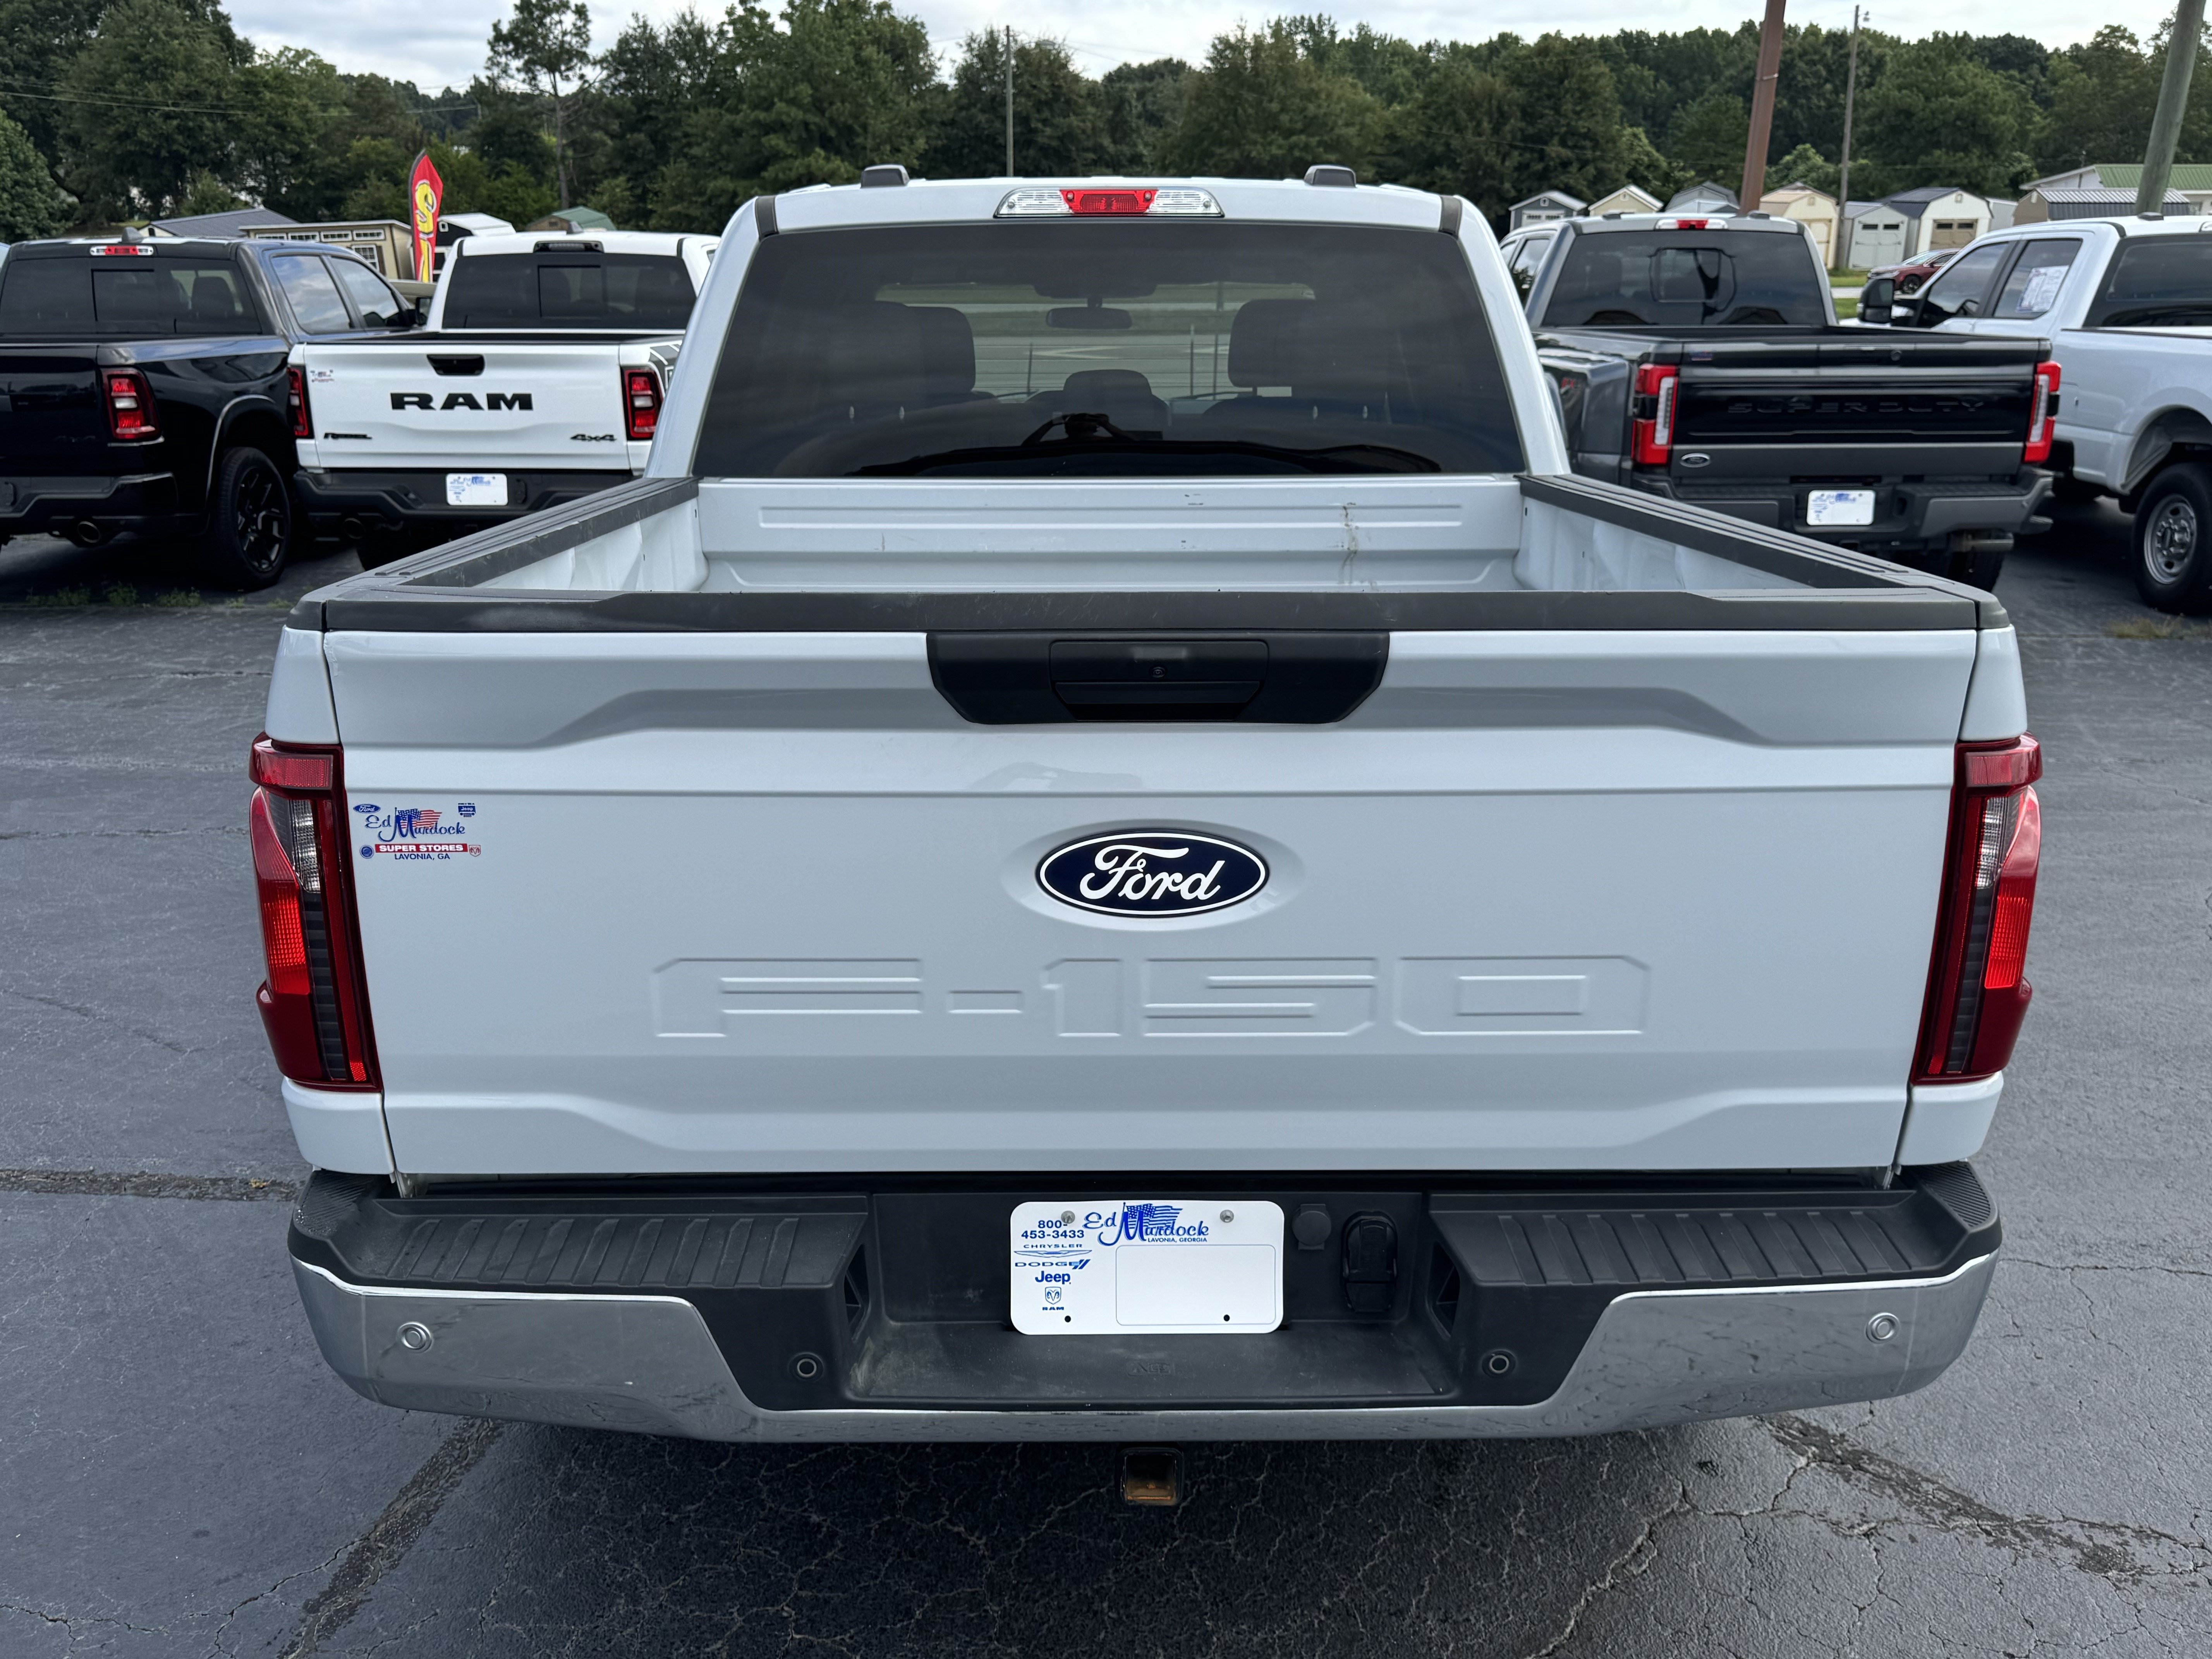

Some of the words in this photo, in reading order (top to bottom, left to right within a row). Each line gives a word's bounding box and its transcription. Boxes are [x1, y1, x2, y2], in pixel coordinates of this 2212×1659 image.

[391, 392, 533, 410] RAM
[1728, 402, 1868, 413] SUPER
[1879, 401, 1984, 412] DUTY
[365, 815, 392, 828] Ed
[378, 813, 465, 842] Murdock
[1079, 844, 1221, 900] Ford
[651, 955, 1651, 1038] F-150
[1038, 1220, 1068, 1229] 800-
[1082, 1211, 1116, 1229] Ed
[1097, 1209, 1209, 1246] Murdock
[1021, 1230, 1085, 1239] 453-3433
[1035, 1271, 1070, 1285] Jeep
